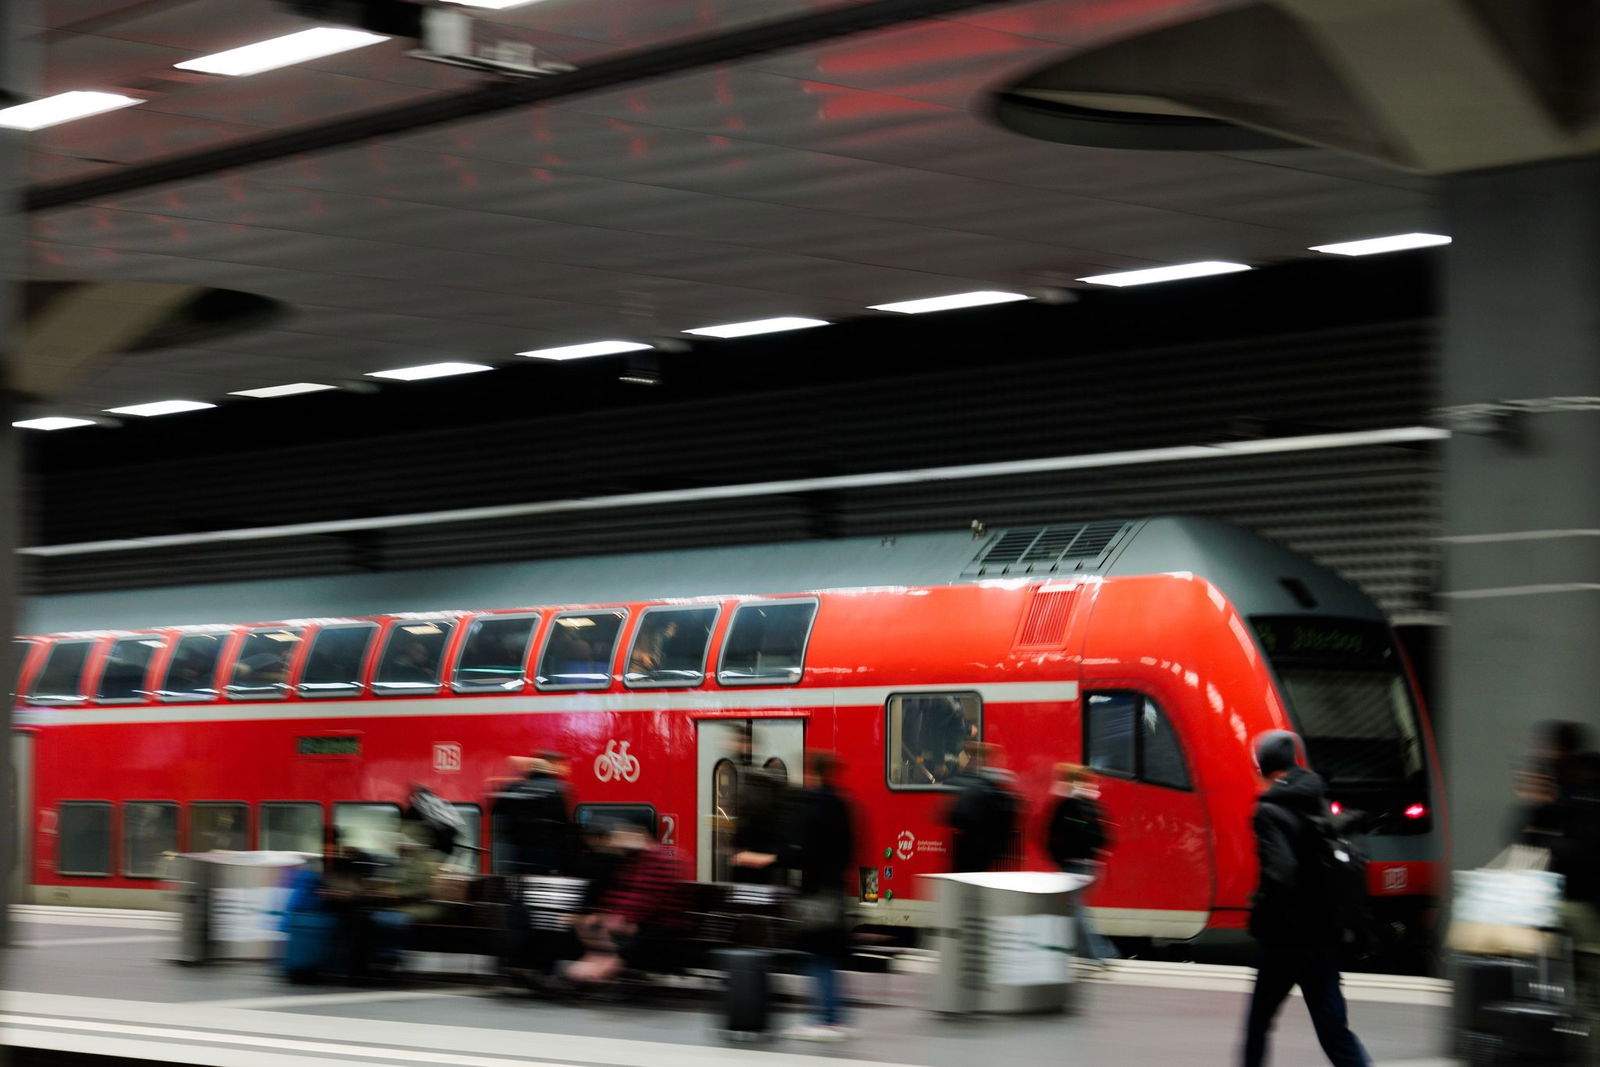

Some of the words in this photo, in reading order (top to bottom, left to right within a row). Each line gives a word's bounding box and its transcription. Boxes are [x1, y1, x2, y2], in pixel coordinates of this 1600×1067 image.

[434, 743, 461, 772] DB
[661, 815, 675, 845] 2
[898, 840, 913, 850] VBB
